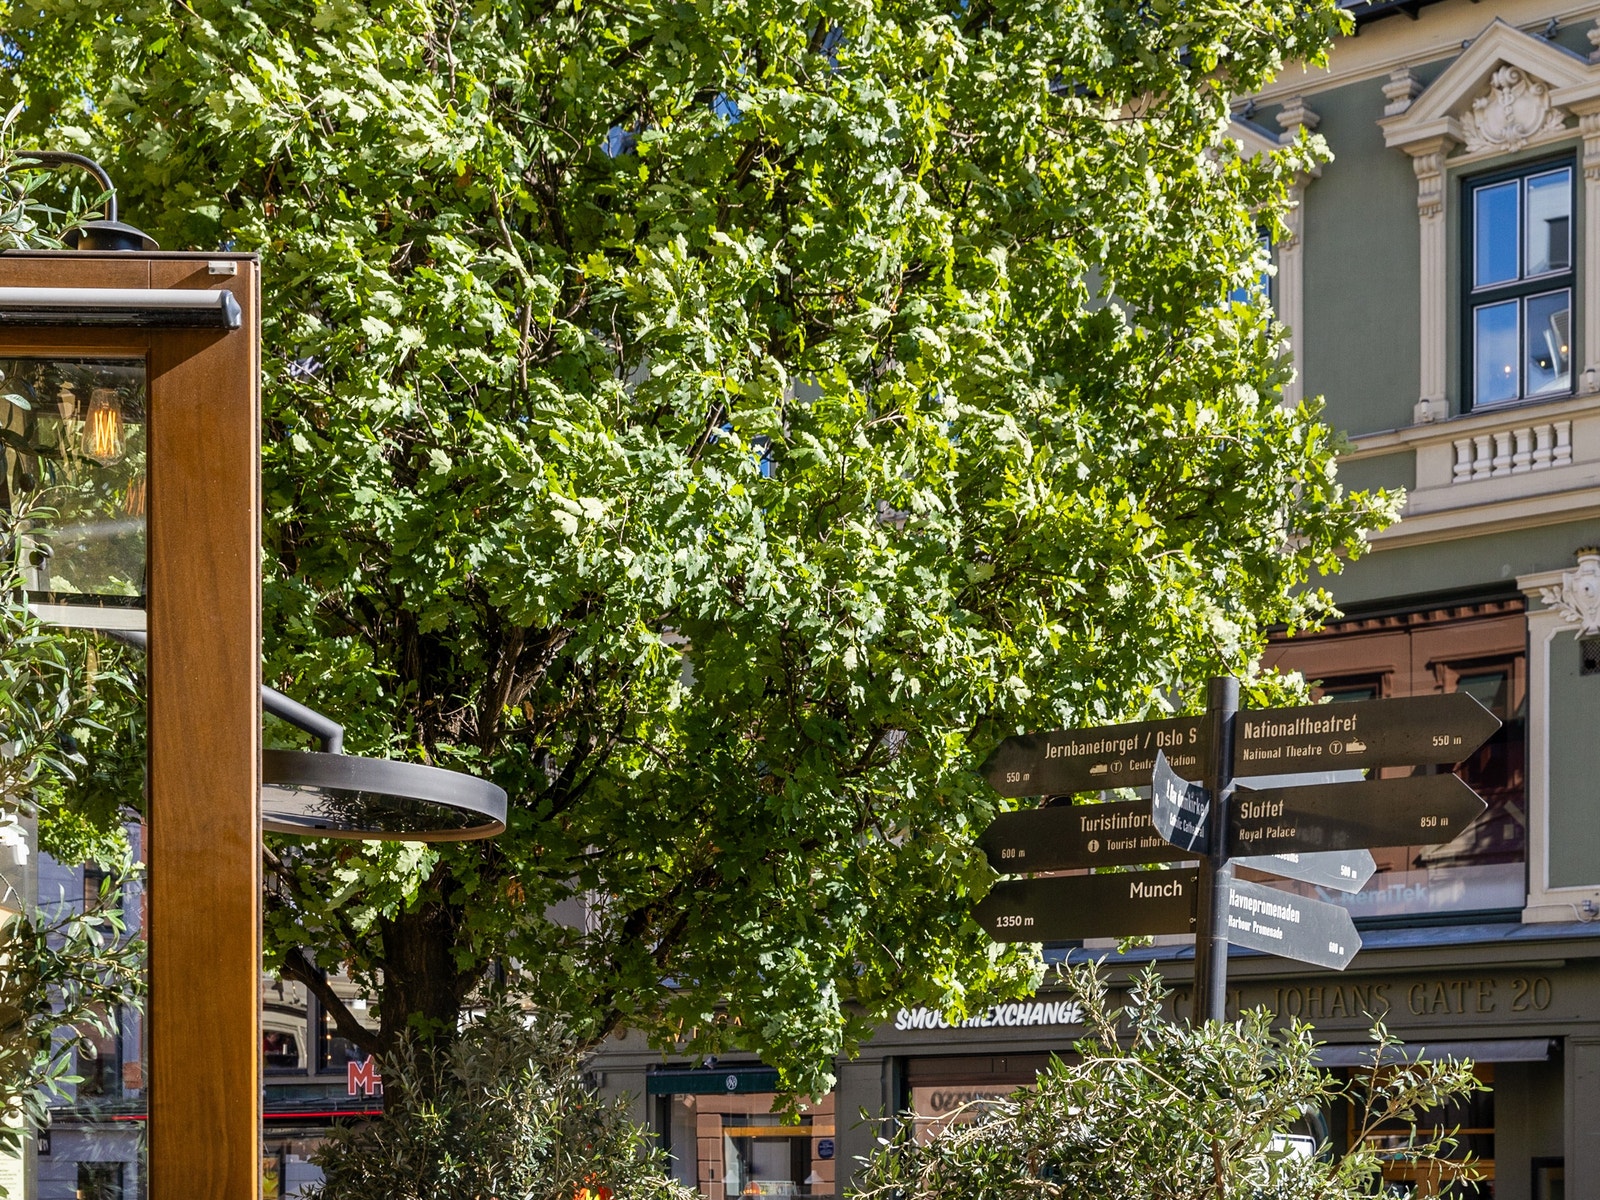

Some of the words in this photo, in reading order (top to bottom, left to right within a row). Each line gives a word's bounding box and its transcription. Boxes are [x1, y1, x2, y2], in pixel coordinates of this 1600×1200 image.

[1243, 713, 1358, 740] Nationaltheatret
[1044, 735, 1140, 760] Jernbanetorget
[1156, 731, 1184, 747] Oslo
[1189, 727, 1197, 745] S
[1432, 736, 1452, 748] 550
[1454, 737, 1463, 747] m
[1243, 748, 1281, 762] National
[1285, 745, 1323, 758] Theatre
[1006, 772, 1021, 784] 550
[1023, 773, 1030, 782] m
[1240, 800, 1285, 820] Slottet
[1420, 817, 1438, 828] 850
[1440, 817, 1449, 827] m
[1239, 830, 1262, 842] Royal
[1266, 827, 1297, 840] Palace
[1106, 837, 1137, 850] Tourist
[1001, 849, 1017, 859] 600
[1018, 849, 1026, 858] m
[1129, 880, 1183, 898] Munch
[1229, 888, 1300, 924] Havnepromenaden
[996, 914, 1021, 927] 1350
[1024, 917, 1034, 925] m
[1228, 915, 1251, 932] Harbour
[1252, 920, 1283, 940] Promenade
[1271, 983, 1391, 1021] JOHANS
[1407, 979, 1497, 1016] GATE
[1510, 977, 1553, 1012] 20
